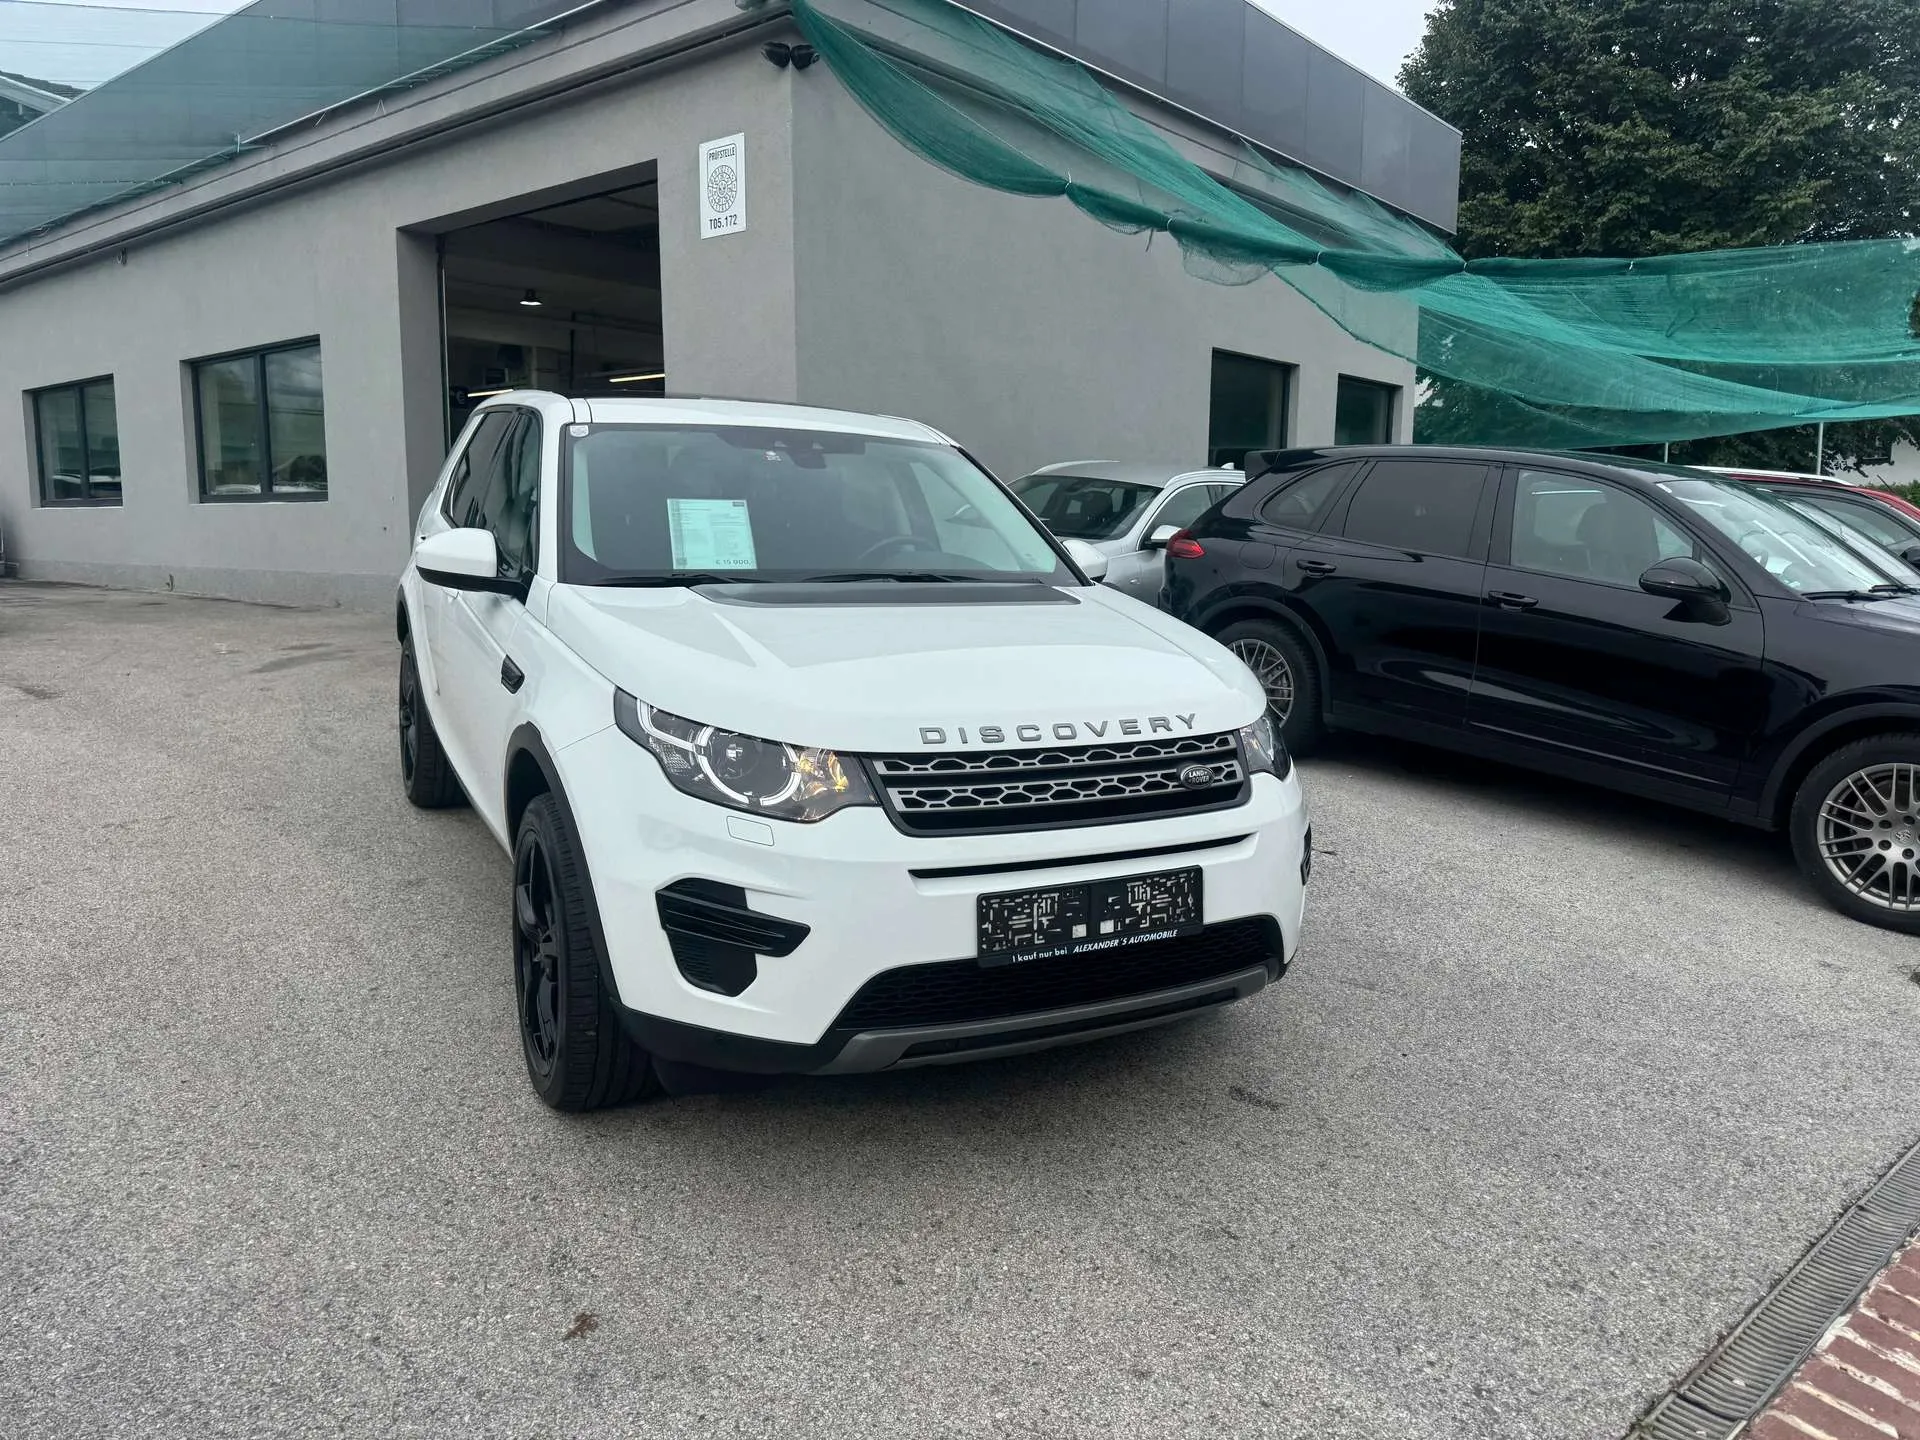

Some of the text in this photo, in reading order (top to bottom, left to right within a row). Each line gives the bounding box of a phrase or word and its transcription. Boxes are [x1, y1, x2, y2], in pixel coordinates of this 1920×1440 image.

[709, 147, 735, 160] PRÜFSTELLE
[709, 214, 738, 230] T05.172
[919, 713, 1196, 745] DISCOVERY
[1189, 769, 1205, 778] LAND
[1191, 775, 1210, 784] ROVER
[1017, 951, 1037, 962] kauf
[1039, 951, 1053, 959] nur
[1054, 946, 1068, 956] bei
[1128, 929, 1178, 944] AUTOMOBILE
